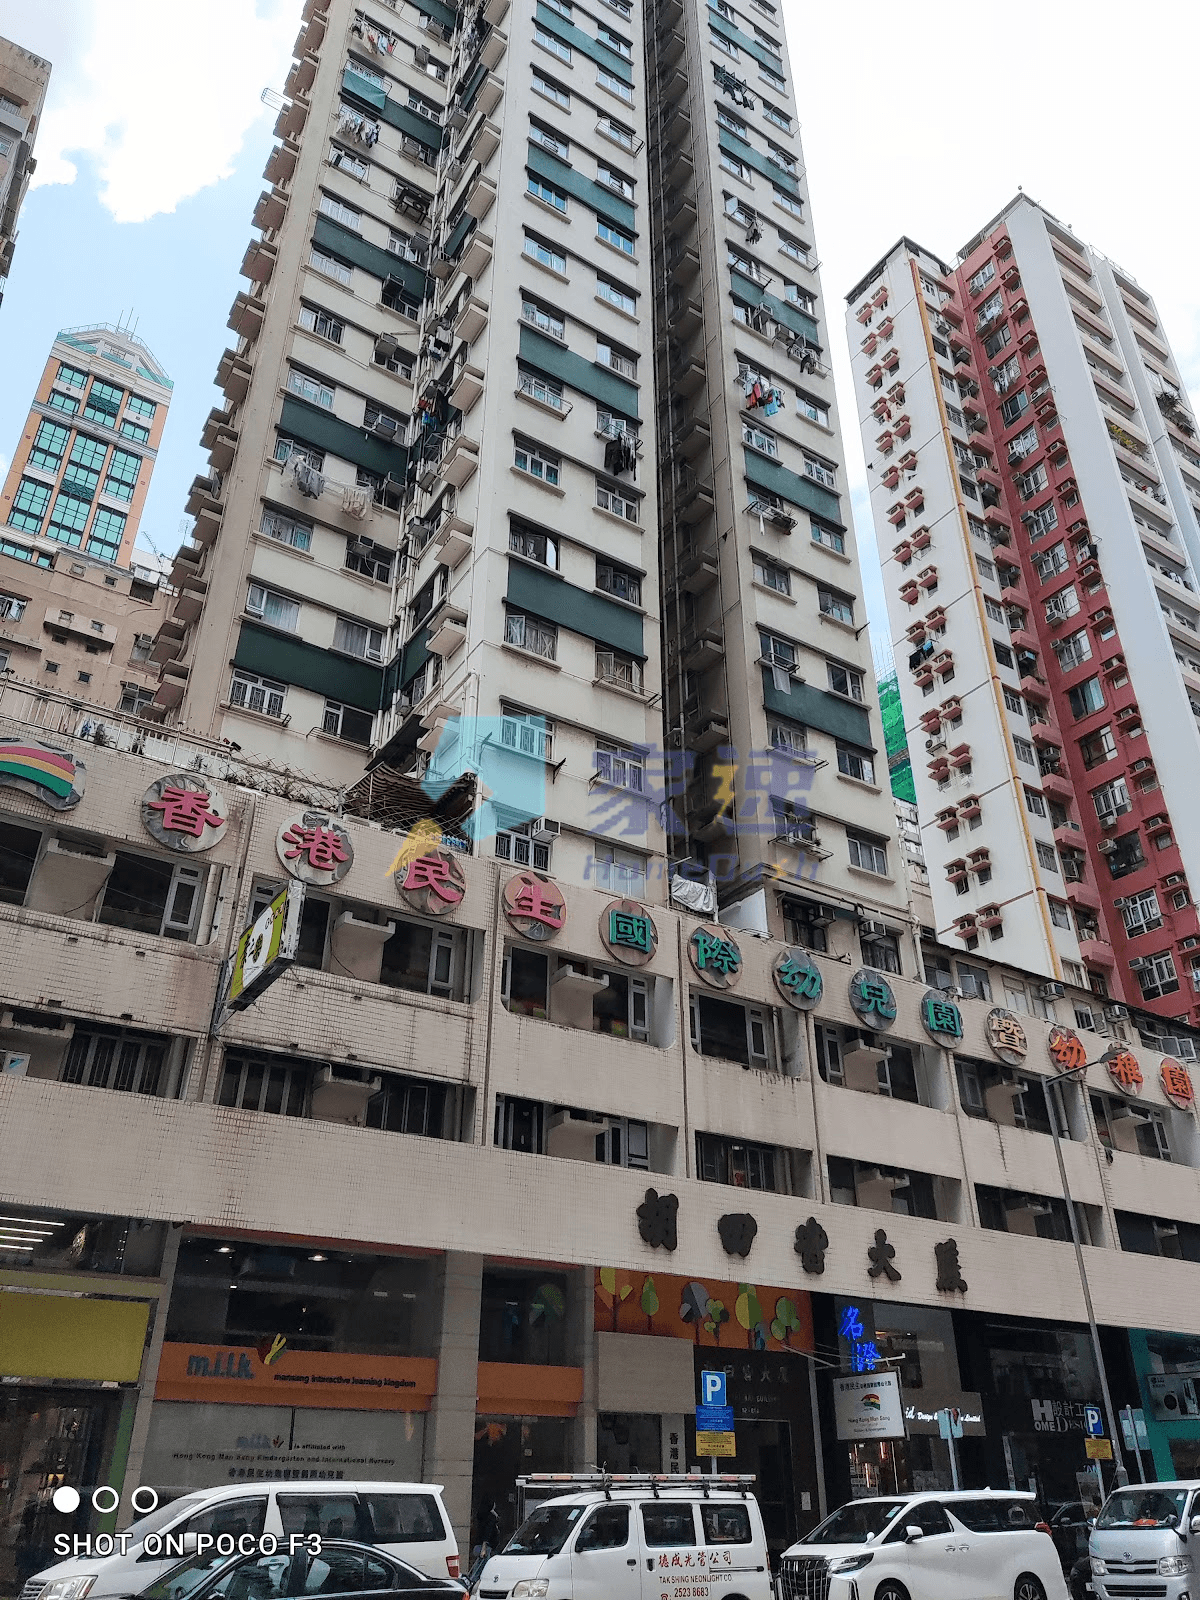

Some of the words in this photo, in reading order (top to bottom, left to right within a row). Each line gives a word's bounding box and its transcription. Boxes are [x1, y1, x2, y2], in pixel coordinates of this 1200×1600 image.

[311, 1375, 350, 1385] interactive
[352, 1377, 382, 1388] learning
[384, 1378, 416, 1388] kingdom
[706, 1374, 722, 1402] P
[1087, 1410, 1099, 1433] P
[659, 1576, 671, 1584] TAK
[671, 1575, 689, 1583] SHING
[674, 1587, 691, 1598] 2523
[692, 1587, 709, 1597] 8683
